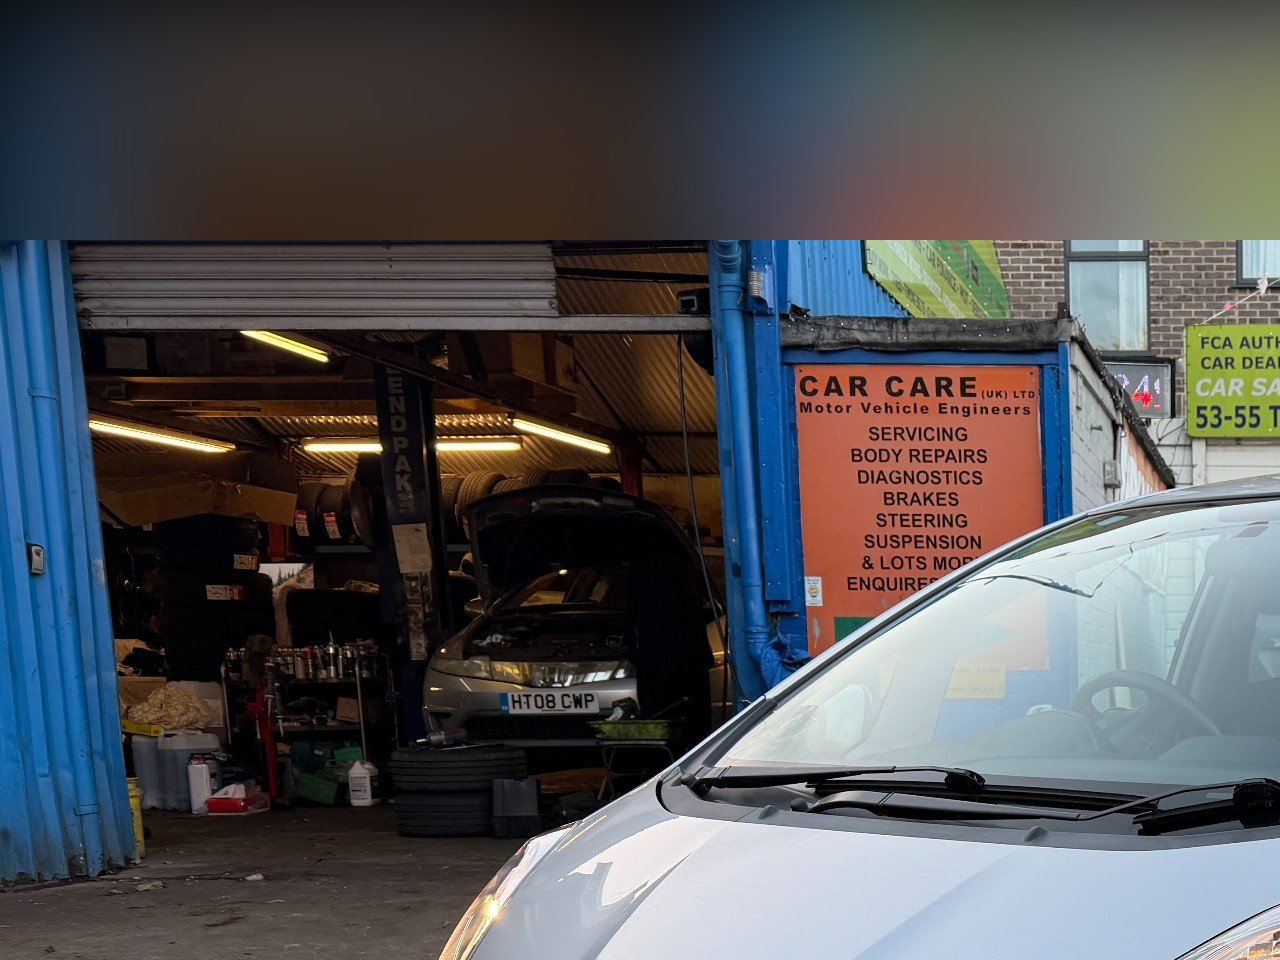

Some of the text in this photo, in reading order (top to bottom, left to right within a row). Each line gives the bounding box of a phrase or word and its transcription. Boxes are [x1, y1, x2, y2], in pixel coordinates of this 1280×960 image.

[1201, 336, 1233, 350] FCA
[1201, 356, 1236, 370] CAR
[799, 375, 1036, 400] CAR CARE (UK) LTD
[1195, 378, 1244, 397] CAR
[799, 402, 1032, 417] Motor Vehicle Engineers
[1196, 405, 1261, 429] 53-55
[868, 426, 968, 442] SERVICING
[850, 448, 988, 463] BODY REPAIRS
[857, 470, 983, 485] DIAGNOSTICS
[883, 491, 959, 506] BRAKES
[876, 513, 968, 528] STEERING
[864, 534, 982, 550] SUSPENSION
[861, 556, 979, 570] & LOTS MOR
[511, 693, 594, 709] HT08 CWP
